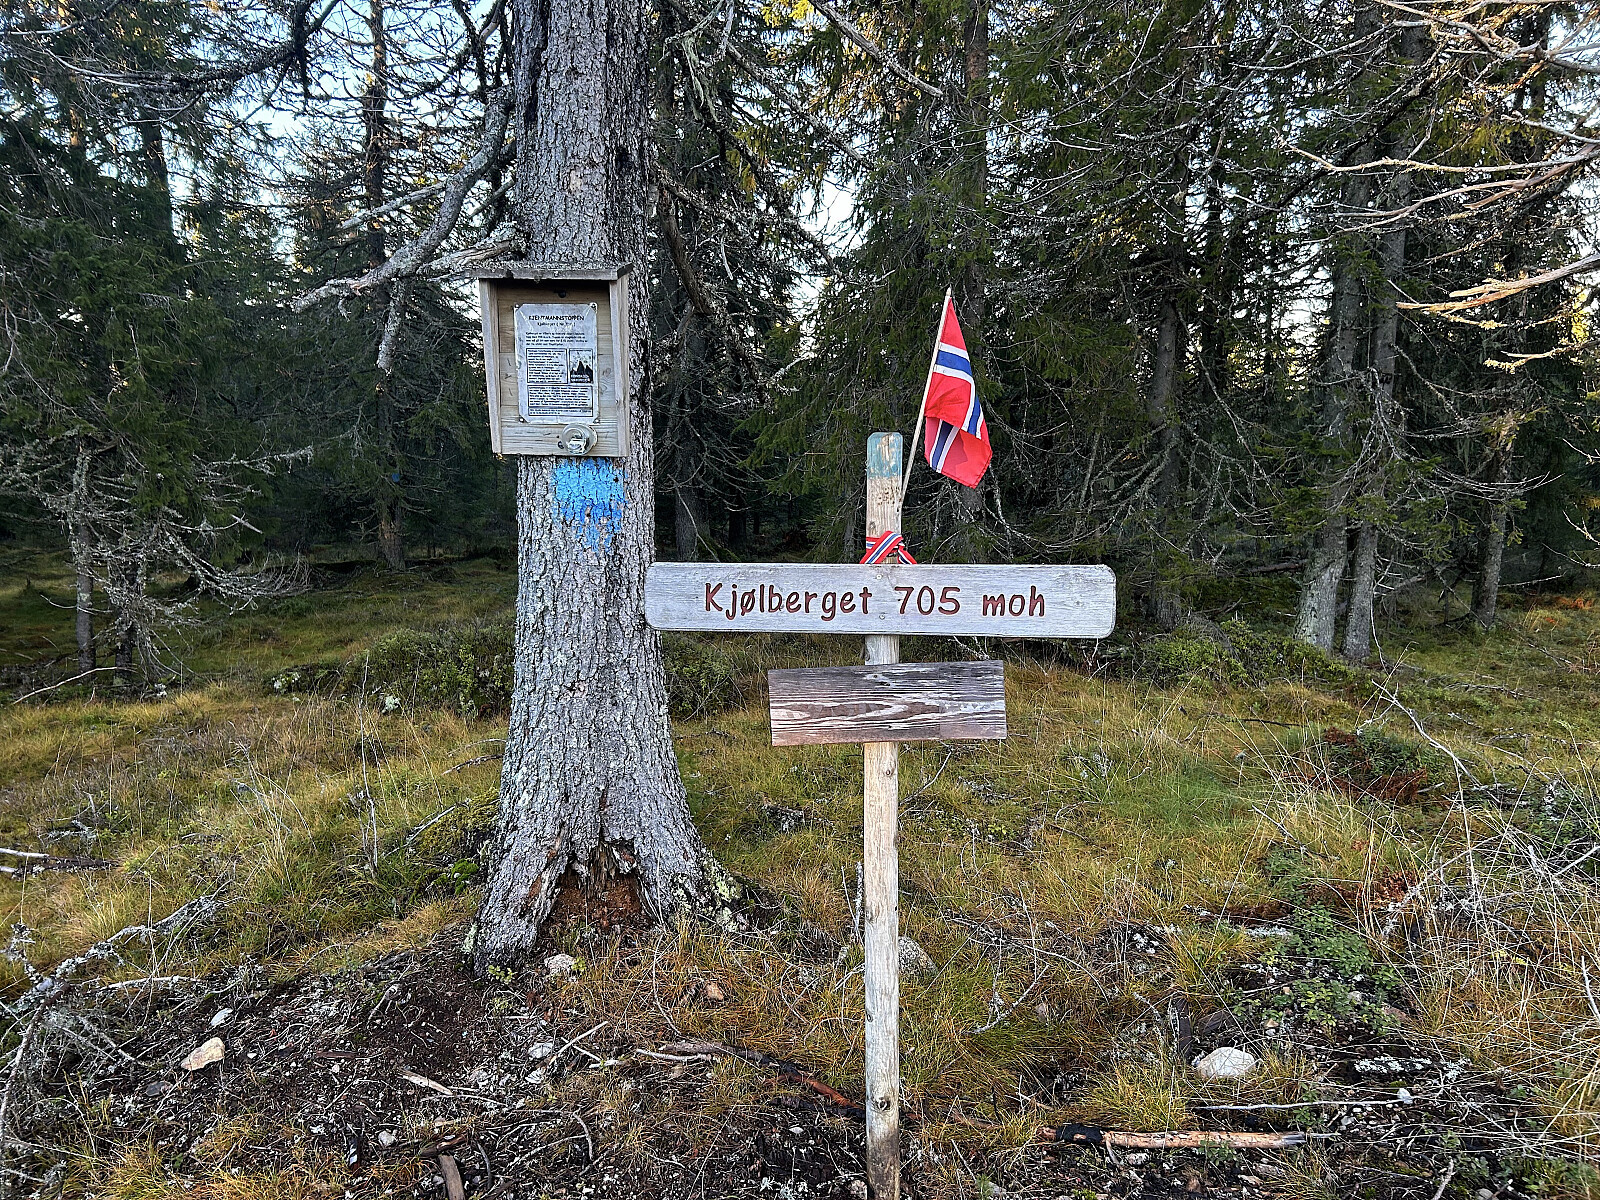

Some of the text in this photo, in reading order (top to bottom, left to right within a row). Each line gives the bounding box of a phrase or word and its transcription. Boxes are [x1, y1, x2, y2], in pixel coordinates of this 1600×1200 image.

[705, 582, 1046, 622] Kjølberget 705 moh
